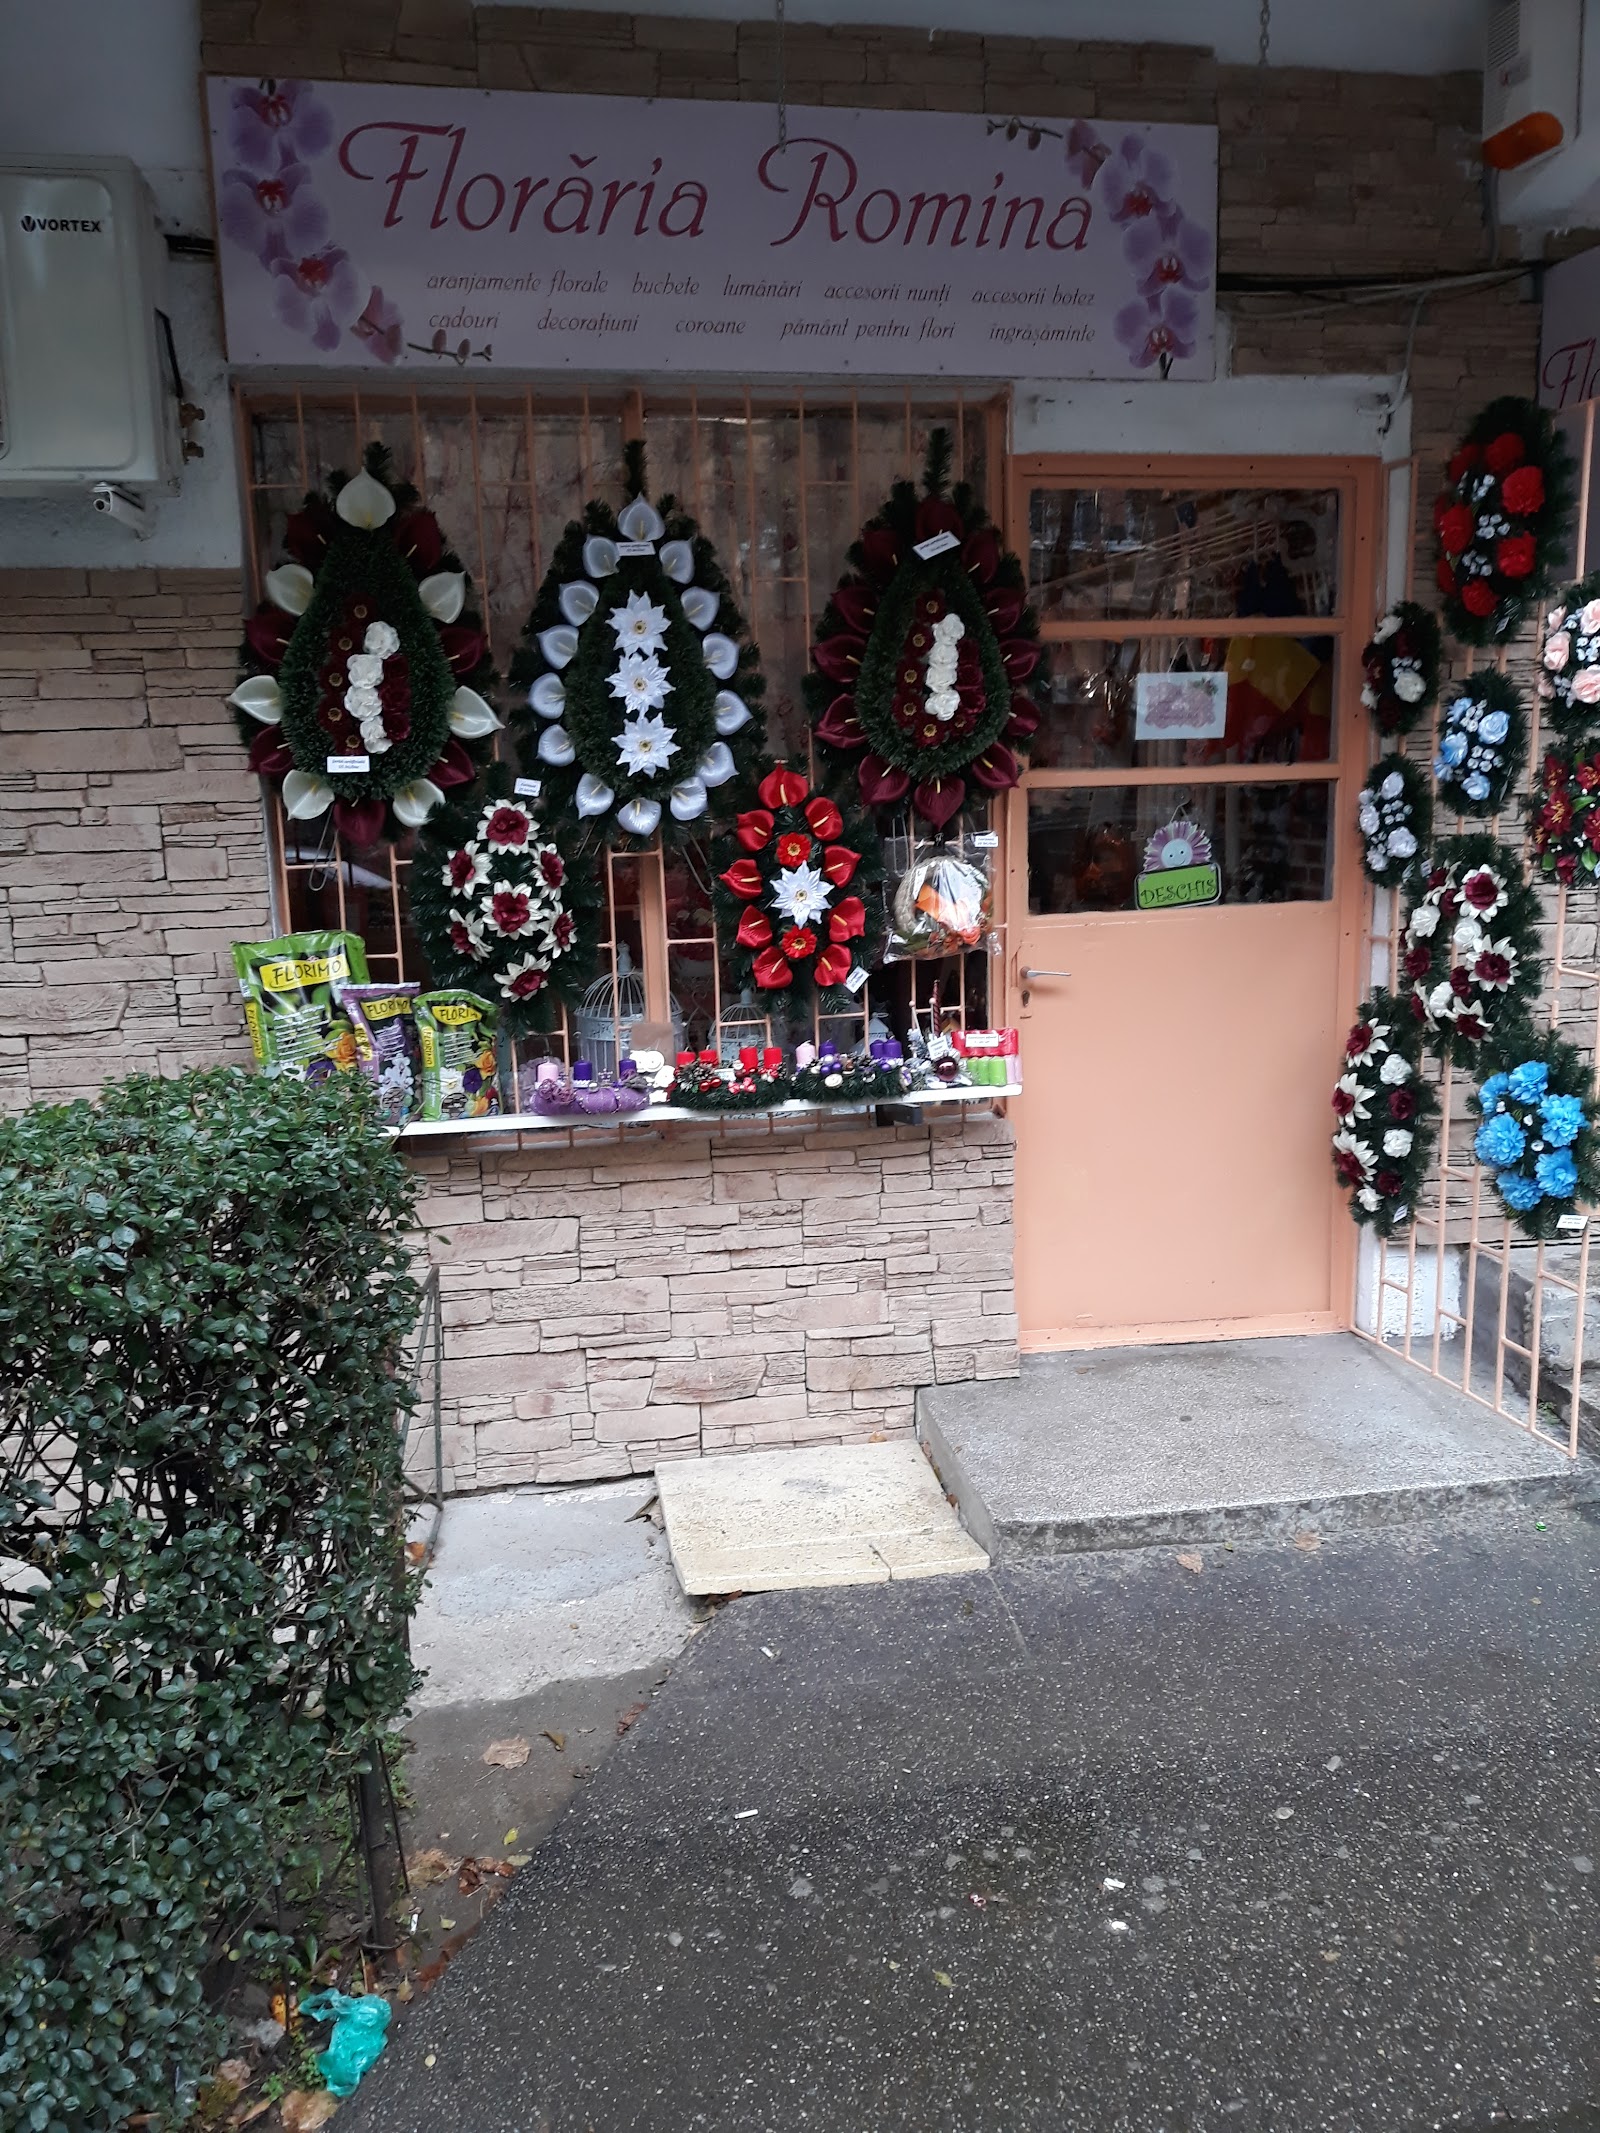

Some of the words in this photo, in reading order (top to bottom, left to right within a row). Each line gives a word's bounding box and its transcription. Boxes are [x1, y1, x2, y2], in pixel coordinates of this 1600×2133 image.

[338, 121, 709, 238] Florăria
[757, 137, 1093, 251] Romina
[36, 218, 102, 233] VORTEX
[427, 271, 542, 296] aranjamente
[547, 269, 609, 297] florale
[632, 272, 700, 296] buchete
[723, 273, 803, 298] lumânări
[824, 283, 900, 303] accesorii
[971, 287, 1046, 305] accesorii
[1052, 283, 1096, 306] botez
[429, 306, 499, 332] cadouri
[537, 308, 640, 337] decorațiuni
[674, 316, 746, 334] coroane
[780, 317, 849, 341] pământ
[855, 318, 911, 341] pentru
[917, 315, 956, 342] flori
[1140, 878, 1217, 905] DESCHIS
[271, 958, 342, 987] FLORIMO
